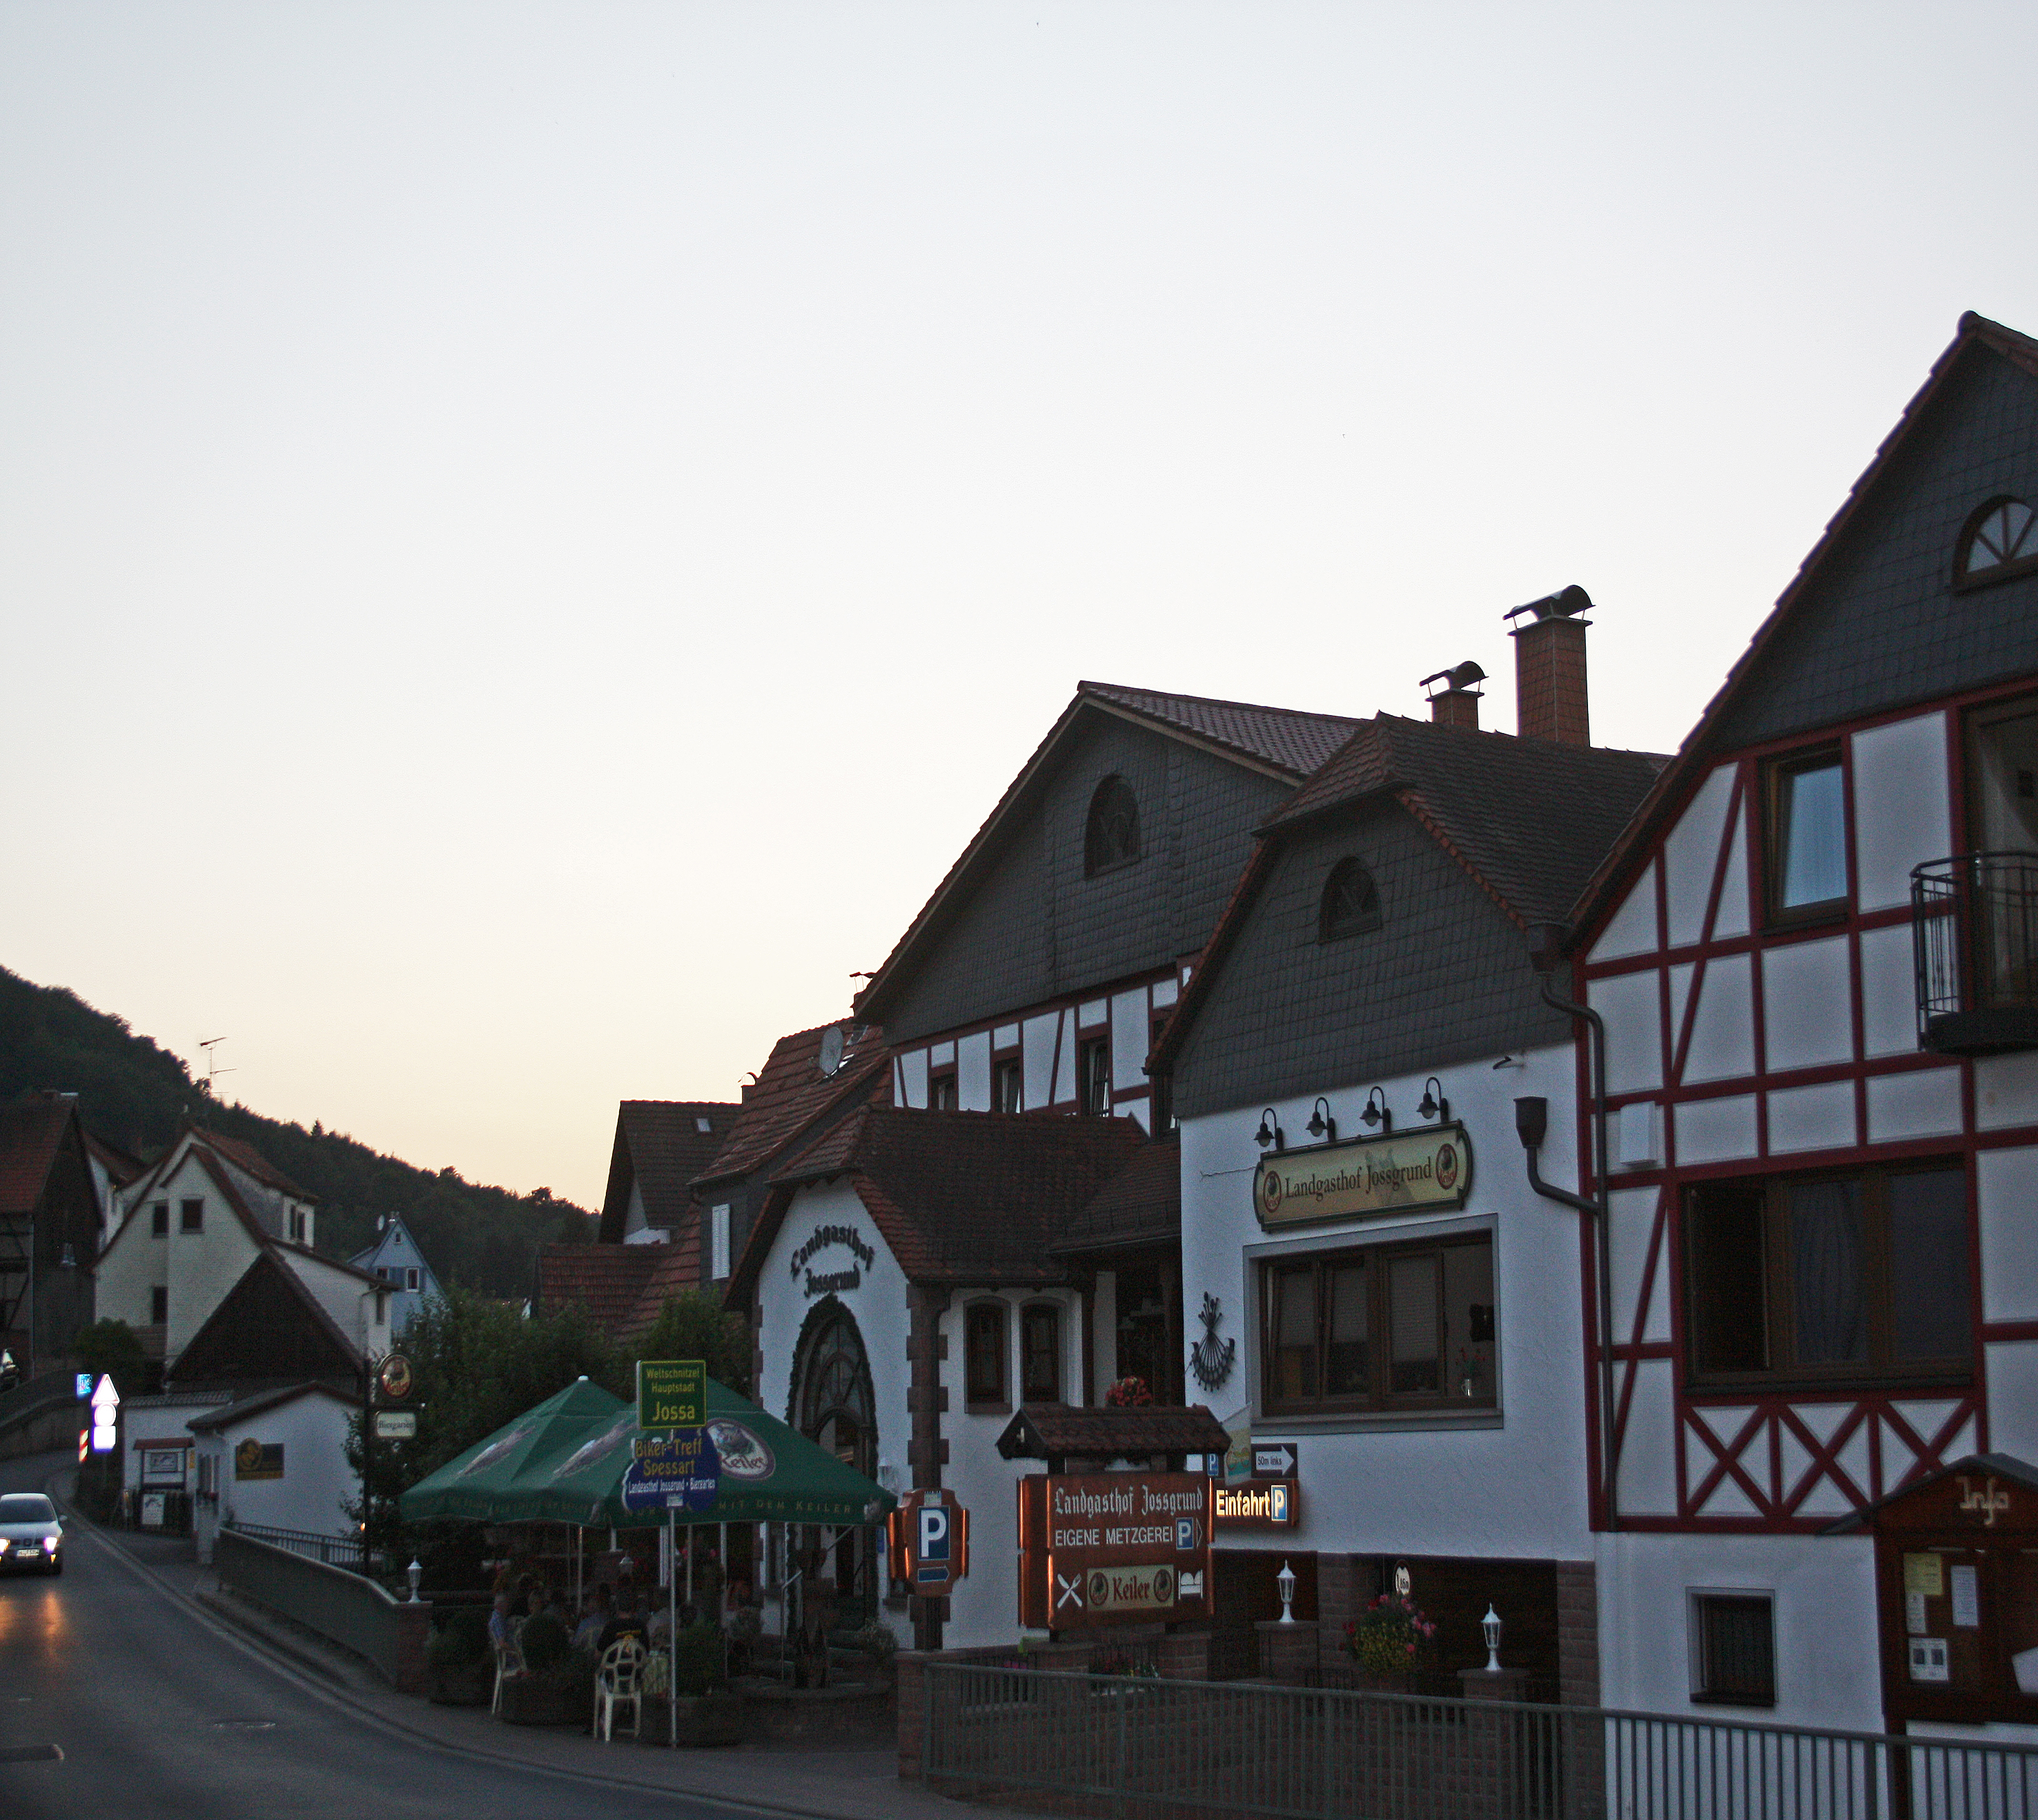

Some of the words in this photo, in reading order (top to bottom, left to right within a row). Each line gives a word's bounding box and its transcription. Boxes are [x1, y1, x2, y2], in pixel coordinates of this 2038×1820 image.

[1285, 1166, 1362, 1202] Landgasthof
[1365, 1156, 1431, 1194] Jossgrund
[791, 1224, 874, 1281] Landgasthof
[804, 1260, 860, 1298] Jossgrund
[646, 1367, 700, 1379] Weltschnitzel
[651, 1382, 696, 1395] Hauptstadt
[651, 1400, 696, 1422] Jossa
[378, 1418, 415, 1431] Biergarten
[635, 1438, 703, 1458] Biker-Treff
[643, 1458, 696, 1476] Spessart
[721, 1452, 766, 1469] Keiler
[1257, 1455, 1269, 1465] 50m
[1270, 1455, 1282, 1465] links
[628, 1479, 659, 1494] Landgasthof
[660, 1478, 685, 1492] Jossgrund
[689, 1476, 716, 1491] Biergarten
[718, 1500, 745, 1510] MIT
[756, 1498, 785, 1510] DEM
[795, 1500, 851, 1514] KEILER
[1055, 1485, 1134, 1519] Landgasthof
[1141, 1483, 1203, 1516] Jossgrund
[1216, 1489, 1271, 1517] Einfahrt
[1275, 1489, 1285, 1518] P
[1954, 1476, 2009, 1525] Info
[921, 1509, 947, 1558] P
[1055, 1528, 1100, 1547] EIGENE
[1106, 1525, 1173, 1545] METZGEREI
[1178, 1520, 1192, 1547] P
[1113, 1575, 1150, 1601] Keiler
